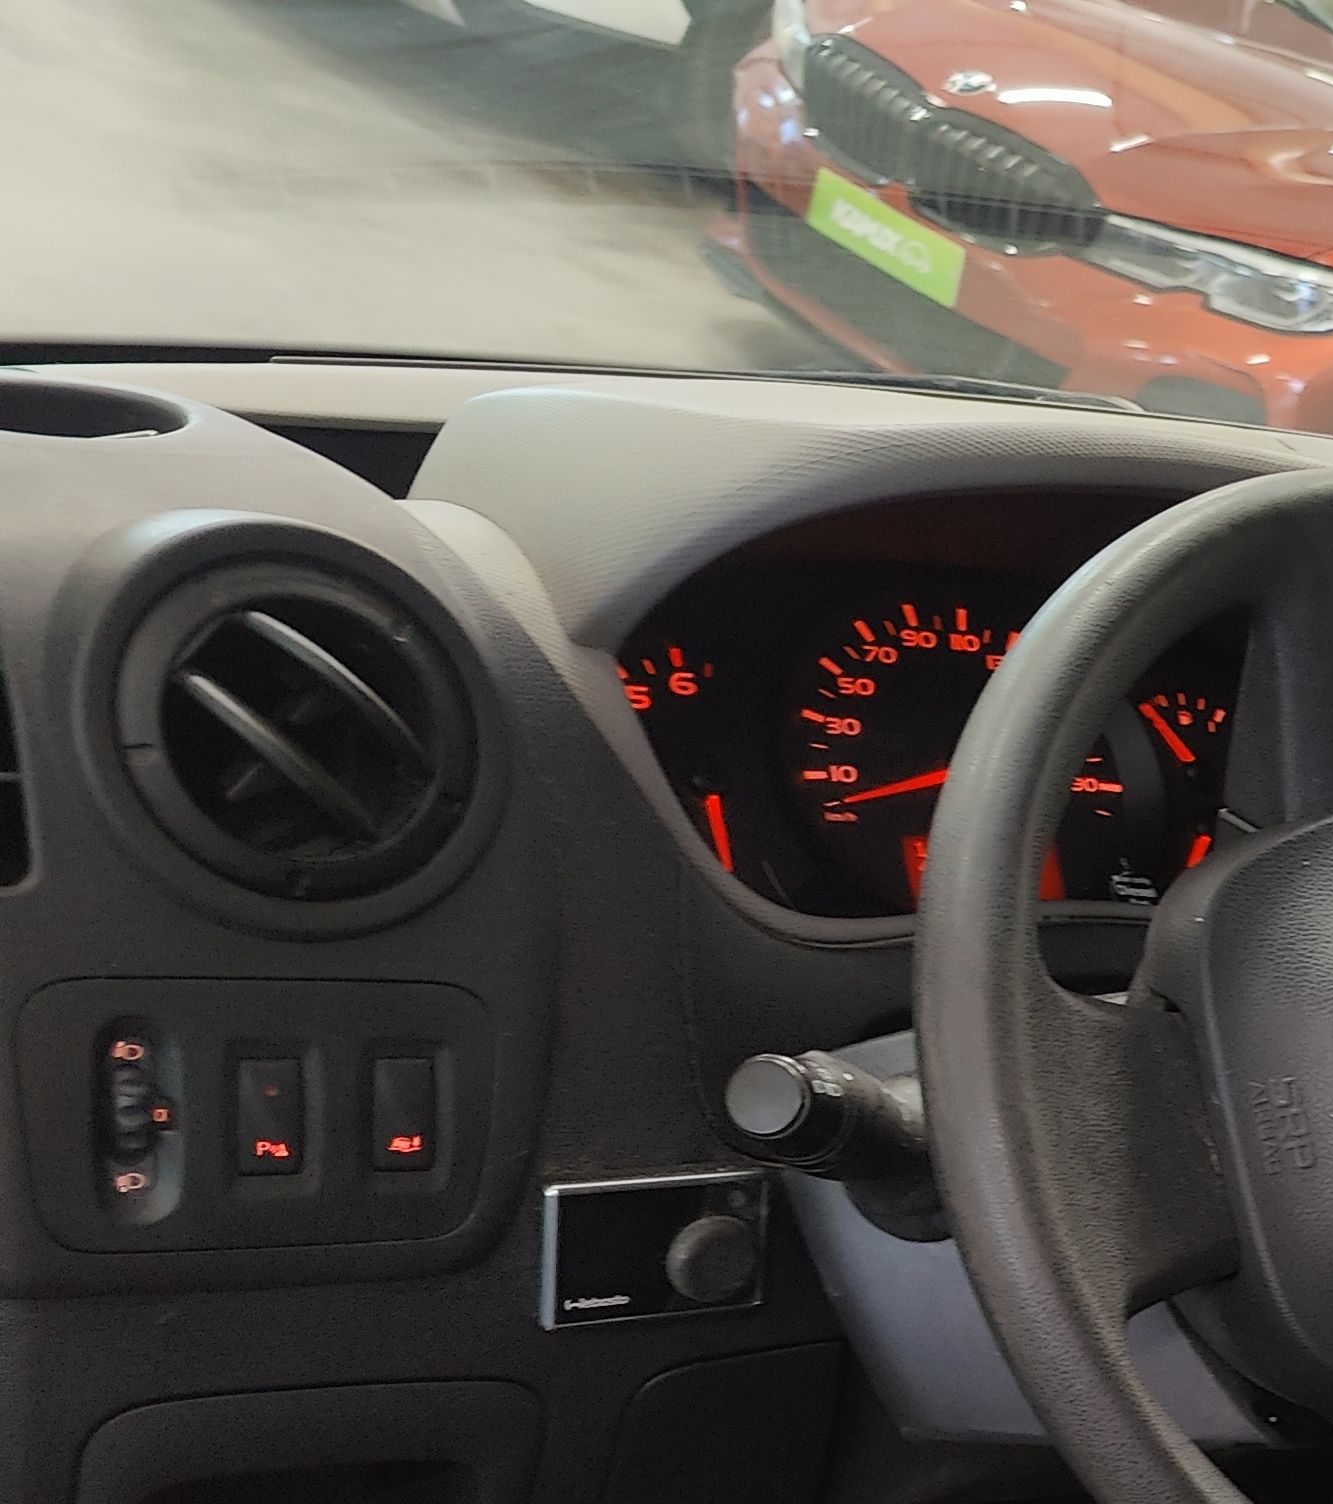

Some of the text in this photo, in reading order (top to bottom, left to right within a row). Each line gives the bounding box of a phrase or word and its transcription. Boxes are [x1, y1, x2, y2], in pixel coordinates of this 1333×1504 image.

[900, 629, 938, 649] 90
[862, 645, 899, 664] 70
[668, 671, 700, 696] 6
[838, 676, 876, 696] 50
[623, 684, 652, 710] 5
[824, 716, 863, 736] 30
[828, 764, 858, 784] 10
